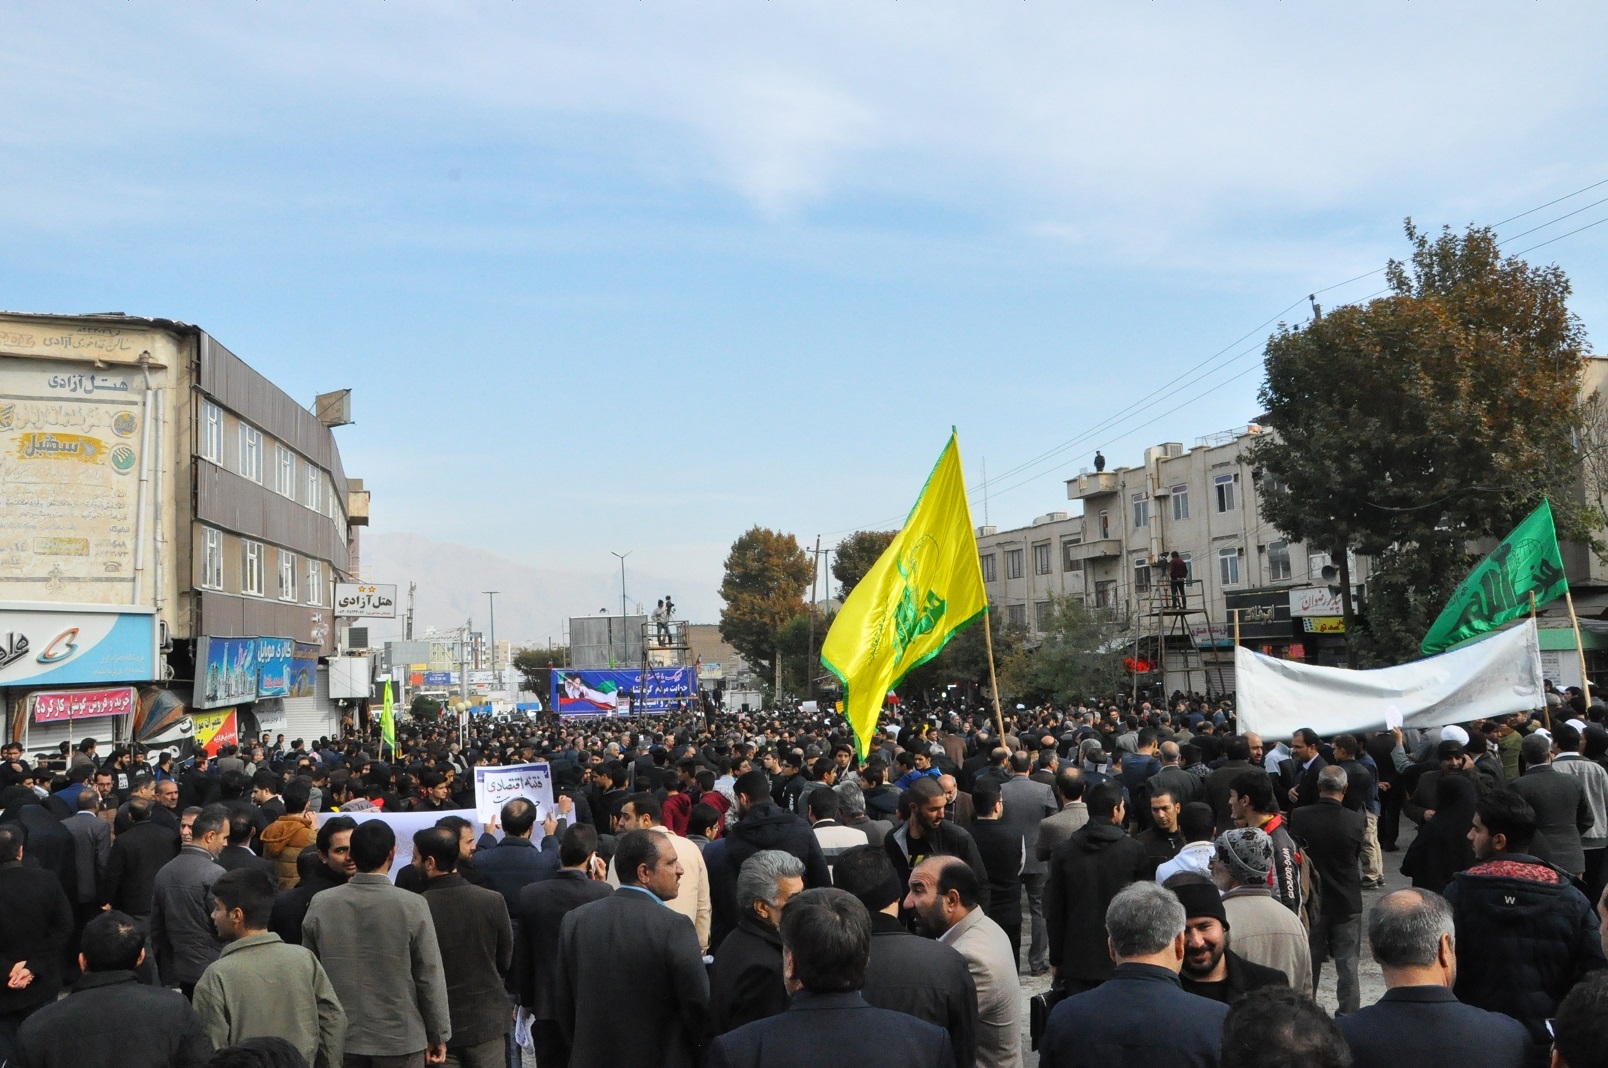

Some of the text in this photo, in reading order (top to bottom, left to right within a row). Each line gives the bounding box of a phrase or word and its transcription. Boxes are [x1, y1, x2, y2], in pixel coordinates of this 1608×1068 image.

[48, 375, 128, 394] هتل آزادی
[338, 594, 393, 609] هتل آزادی
[88, 694, 108, 714] فروش
[114, 693, 130, 711] خرید
[487, 776, 525, 792] اقتصادی
[1504, 895, 1516, 904] W
